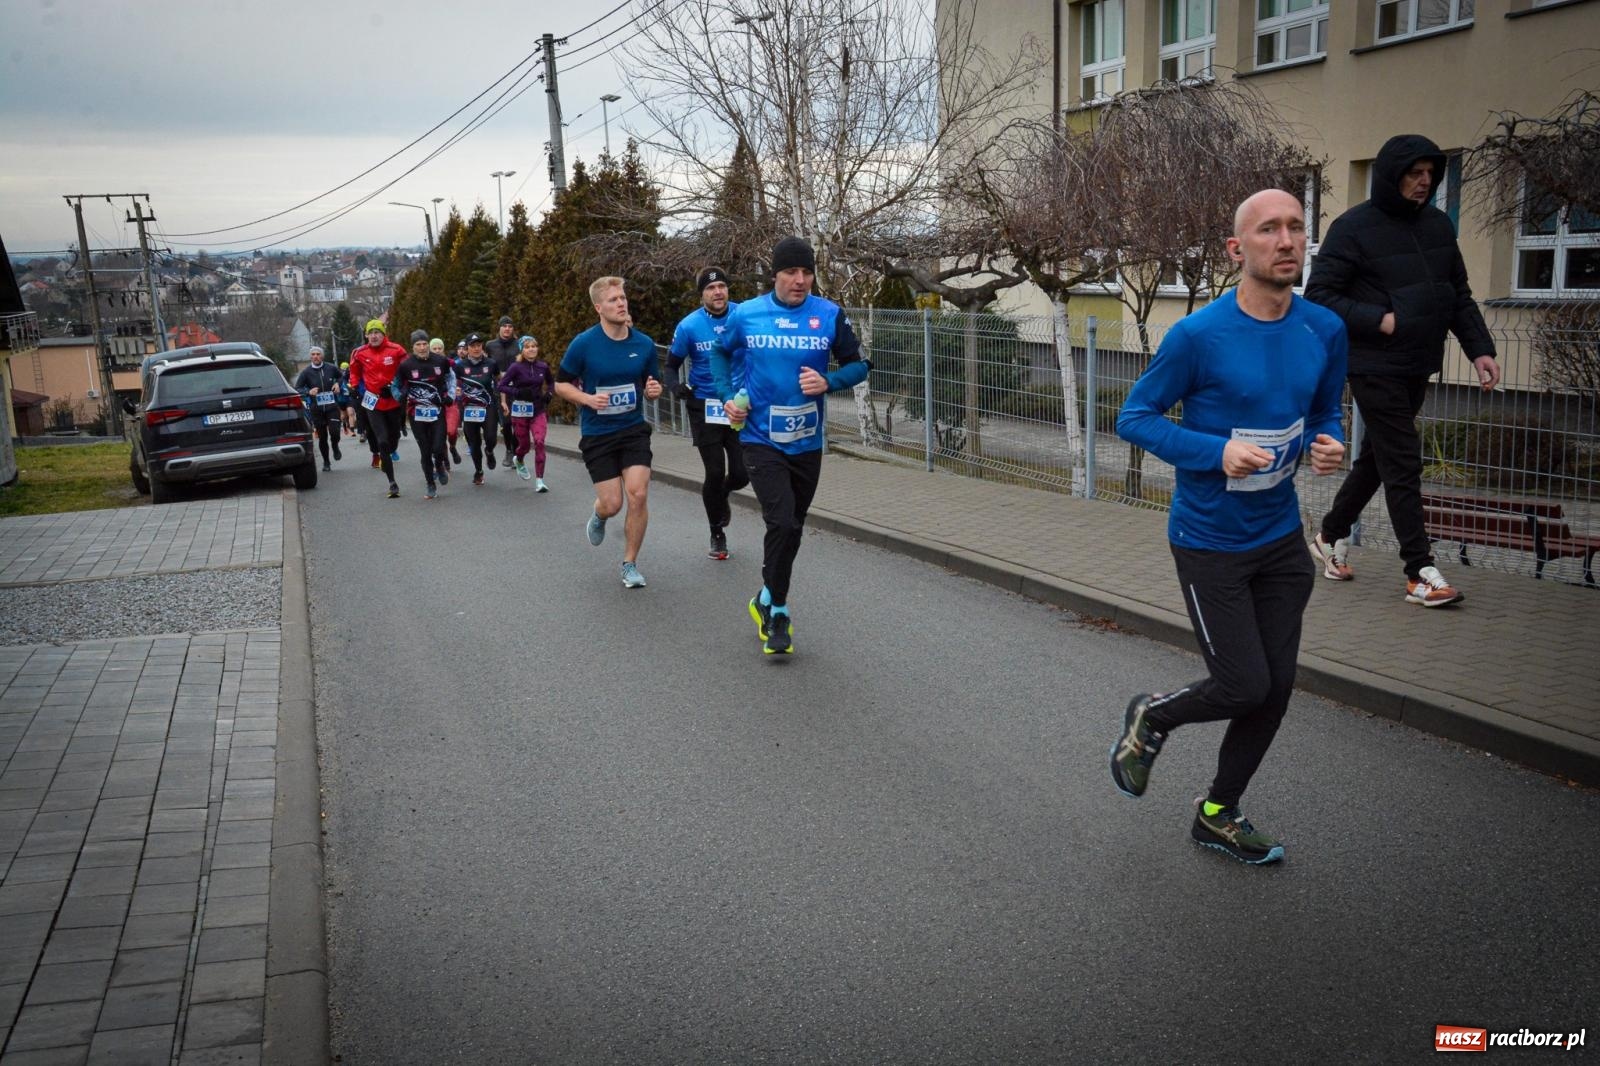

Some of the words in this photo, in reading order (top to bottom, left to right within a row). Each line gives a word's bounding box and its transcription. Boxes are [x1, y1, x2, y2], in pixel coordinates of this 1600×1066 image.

[745, 335, 830, 350] RUNNERS
[209, 414, 221, 424] OP
[785, 415, 806, 431] 32
